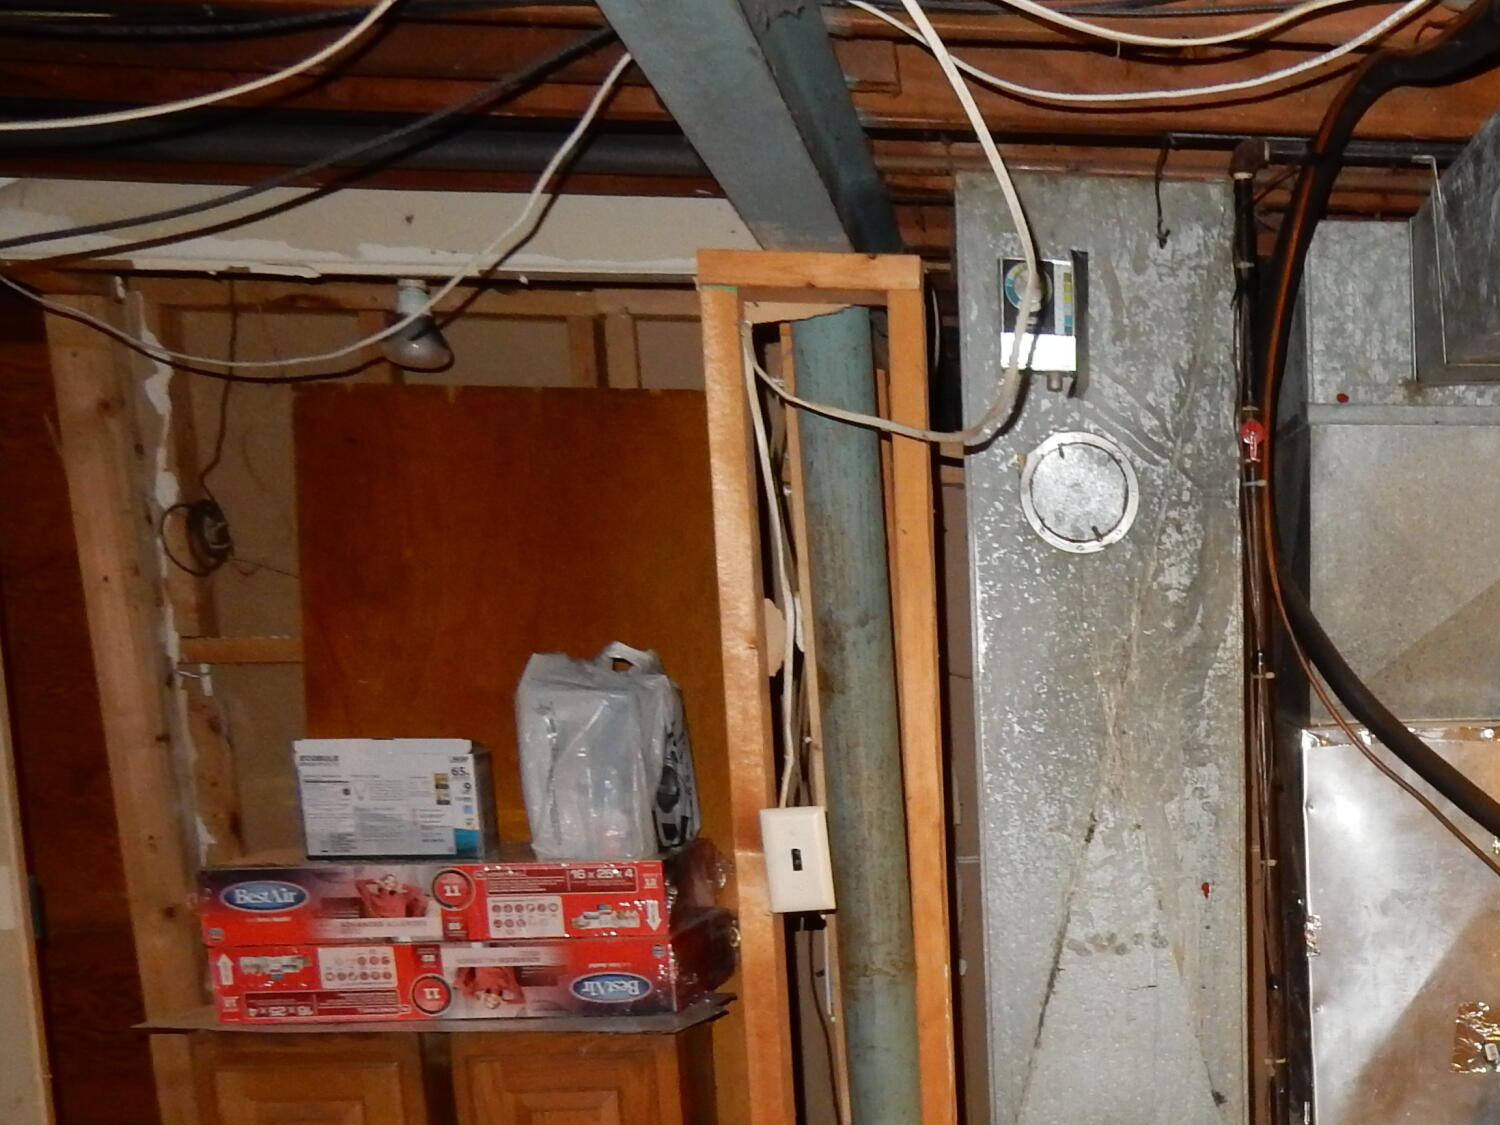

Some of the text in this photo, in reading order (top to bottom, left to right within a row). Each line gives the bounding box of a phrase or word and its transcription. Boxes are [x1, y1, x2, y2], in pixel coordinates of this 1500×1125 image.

[234, 887, 298, 904] BestAir
[443, 884, 462, 896] 11
[581, 980, 640, 996] BestAir
